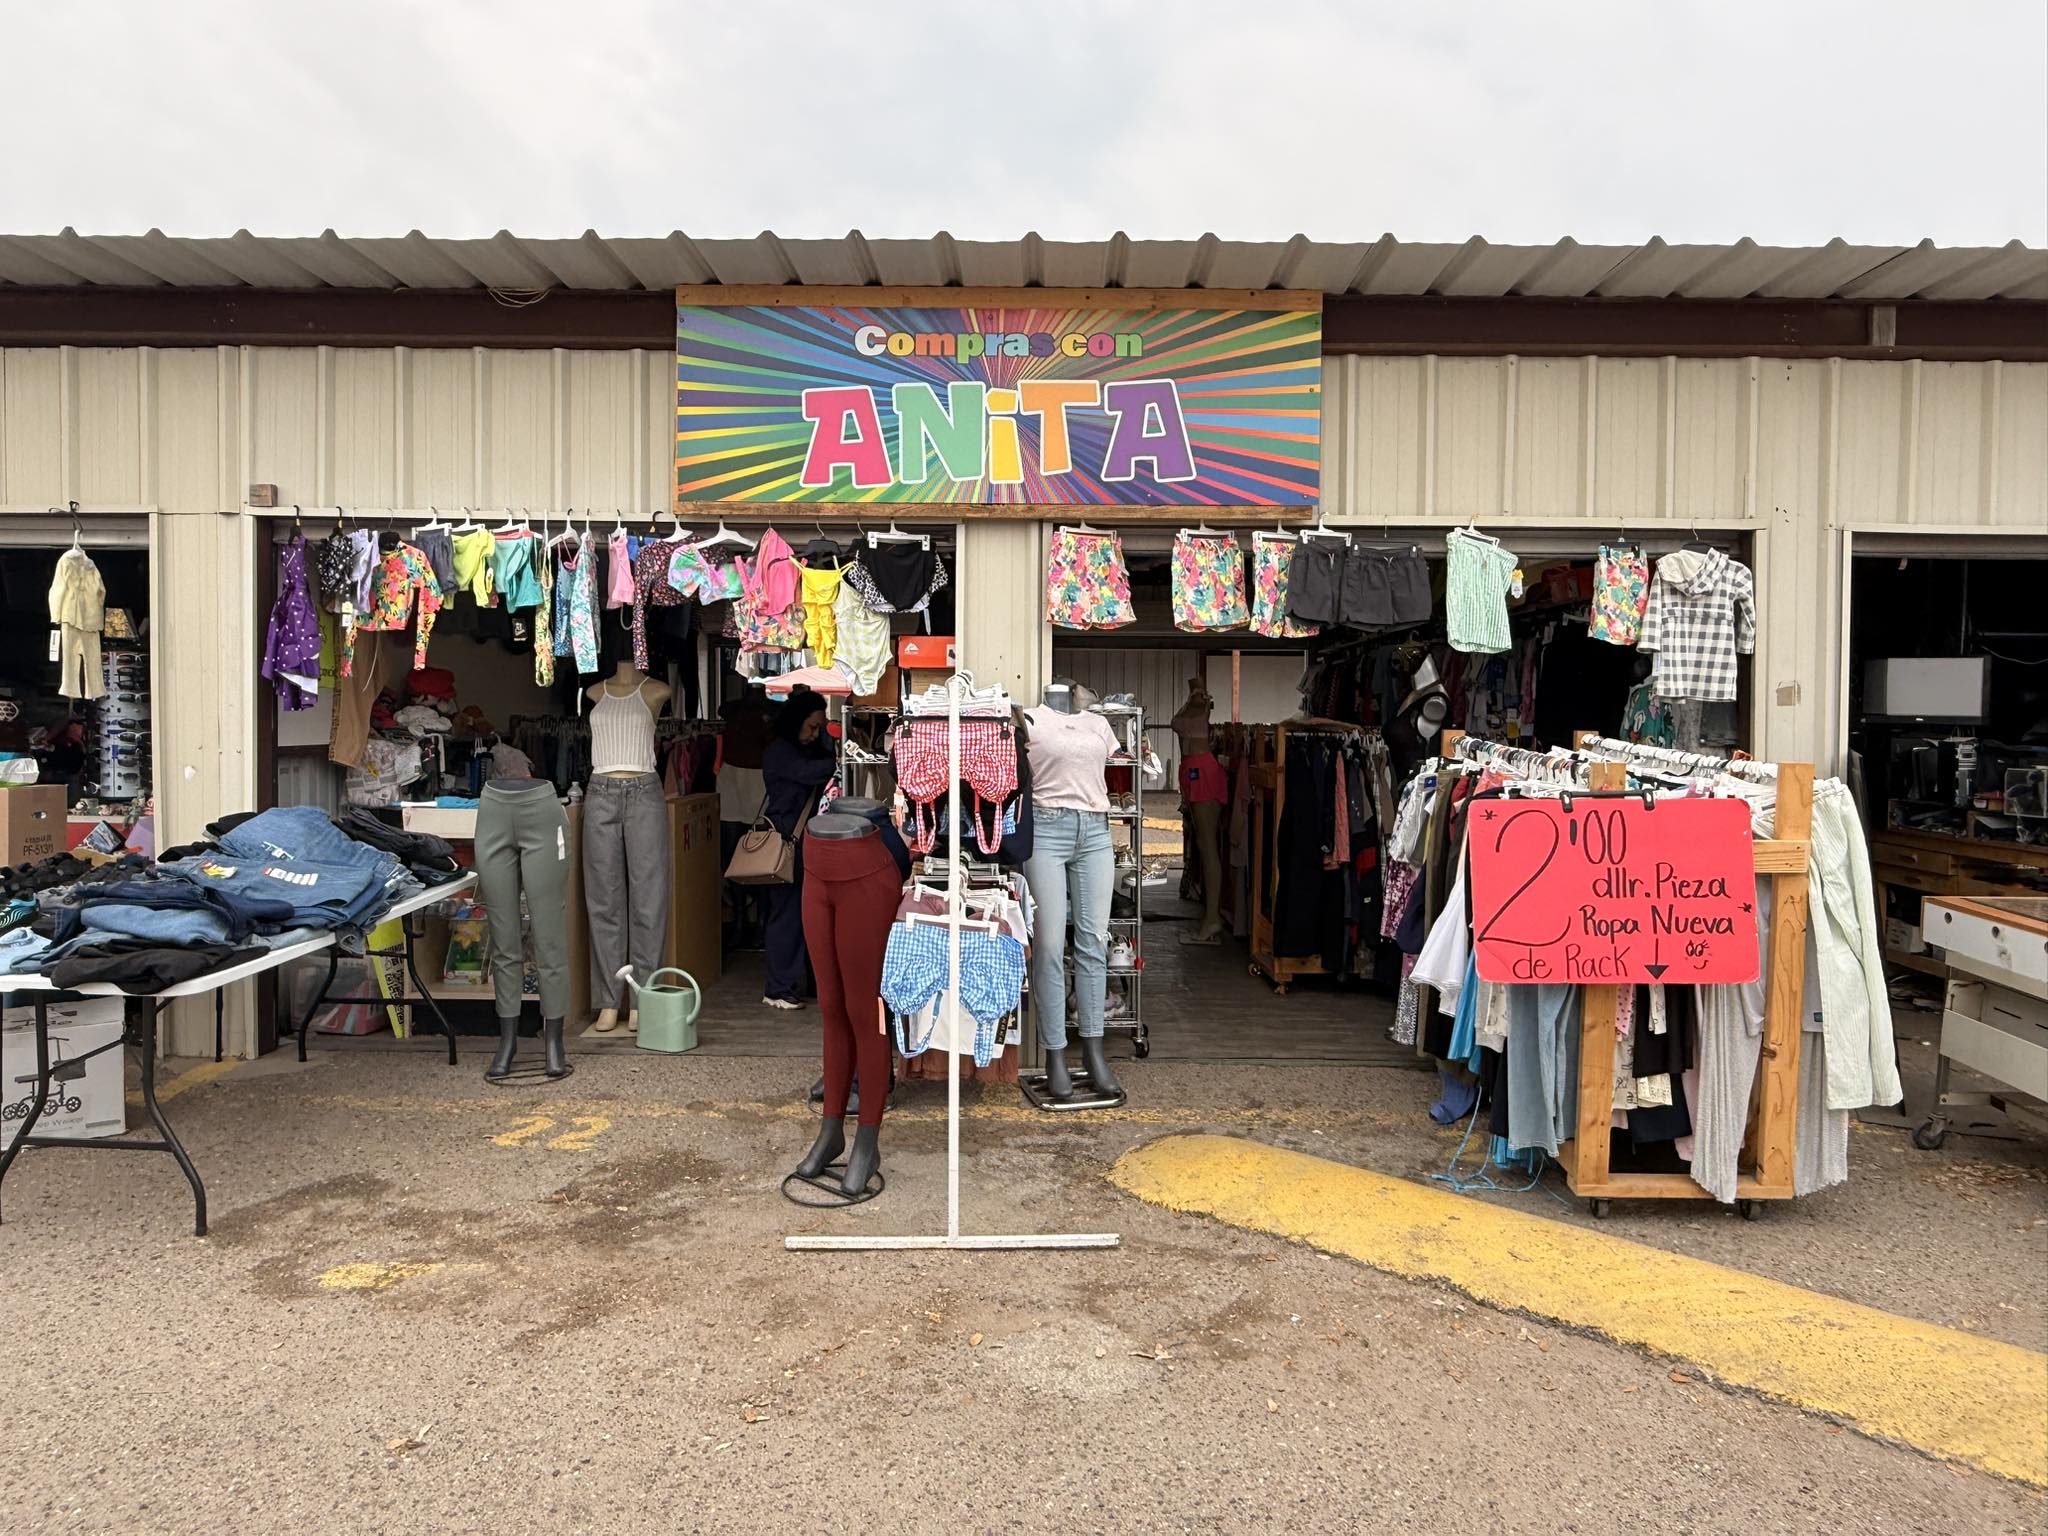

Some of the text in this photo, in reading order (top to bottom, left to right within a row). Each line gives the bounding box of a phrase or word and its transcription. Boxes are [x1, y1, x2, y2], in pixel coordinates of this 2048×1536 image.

[854, 324, 1144, 364] Compras con
[1655, 862, 1732, 899] Pieza
[1579, 904, 1735, 943] Ropa Nueva
[1512, 943, 1629, 980] de Rack
[491, 1115, 611, 1151] 22
